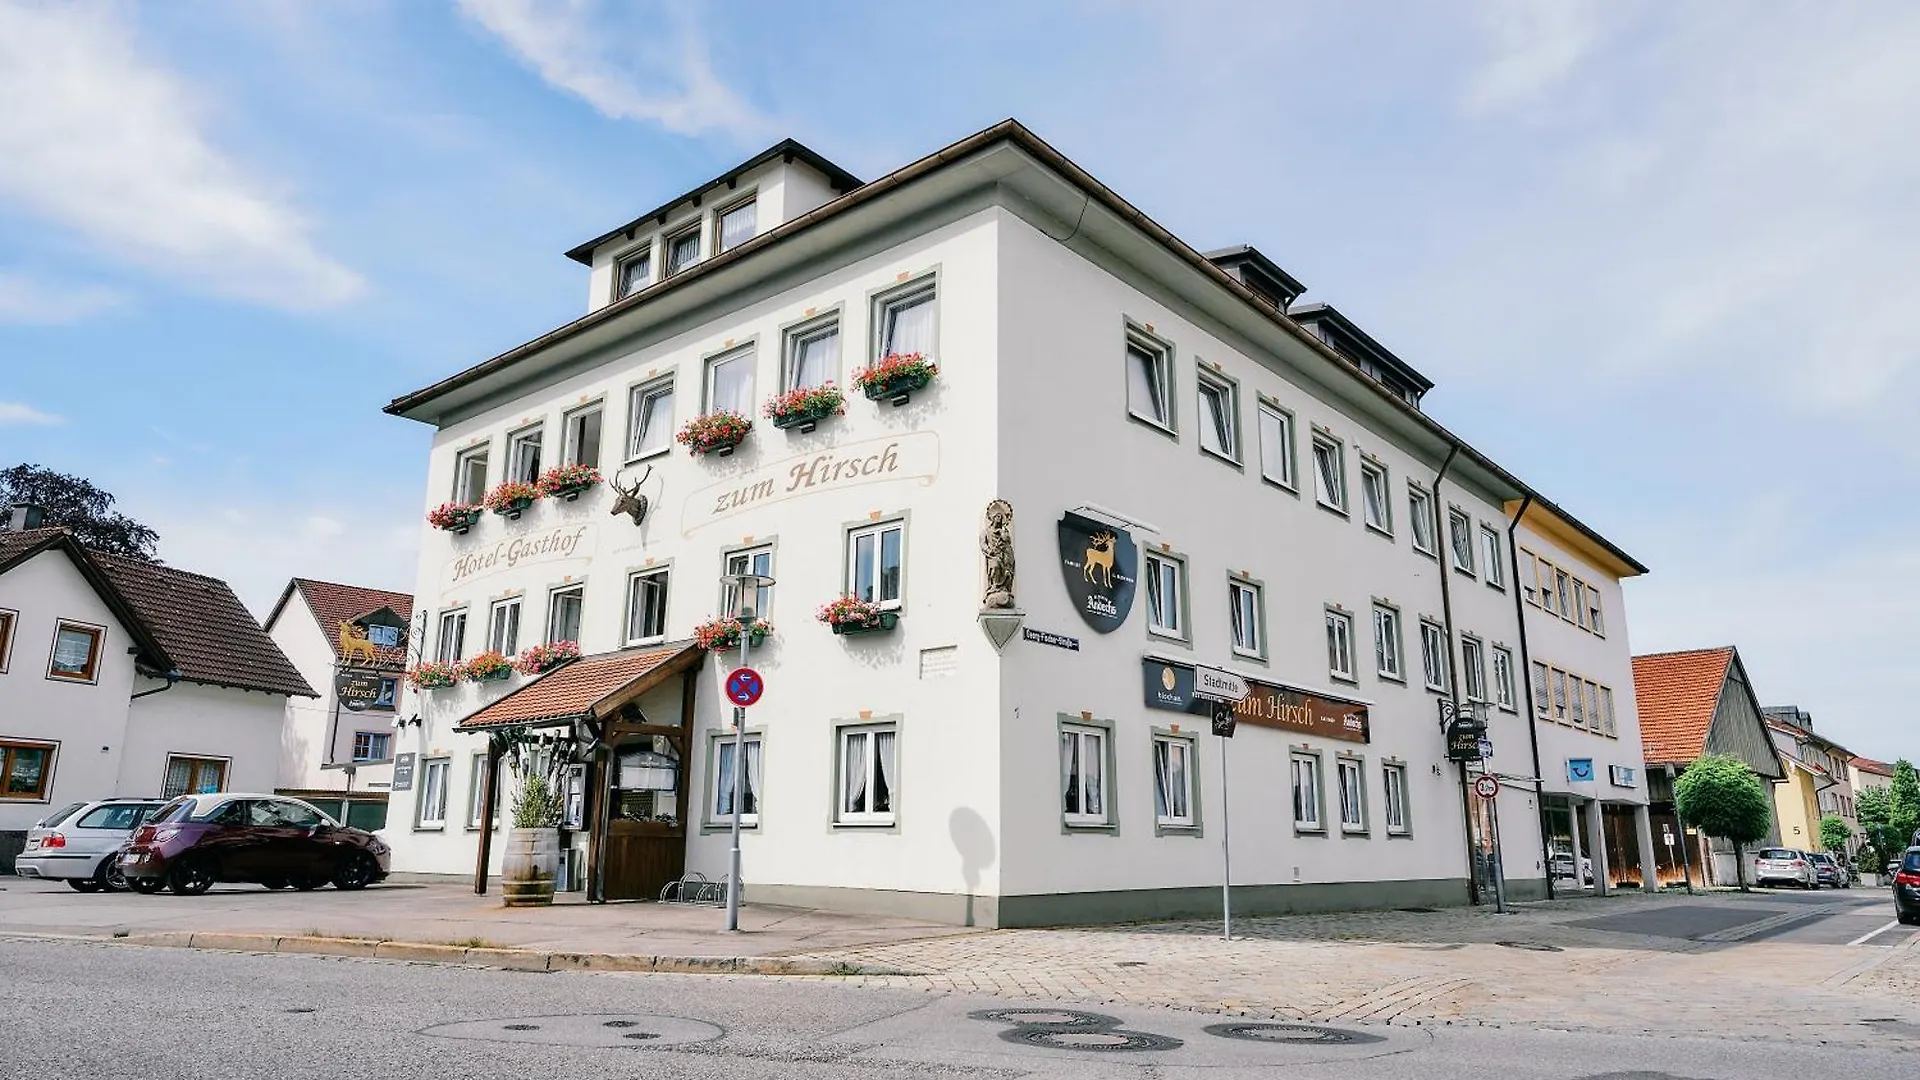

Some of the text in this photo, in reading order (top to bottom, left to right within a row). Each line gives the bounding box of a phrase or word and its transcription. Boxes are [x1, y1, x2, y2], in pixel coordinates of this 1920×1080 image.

[711, 442, 899, 515] zum Hirsch
[452, 526, 587, 581] Hotel-Gasthof
[339, 685, 377, 698] Hirsch
[1232, 693, 1314, 726] um Hirsch
[1450, 740, 1478, 750] Hirsc
[1793, 826, 1801, 835] 5
